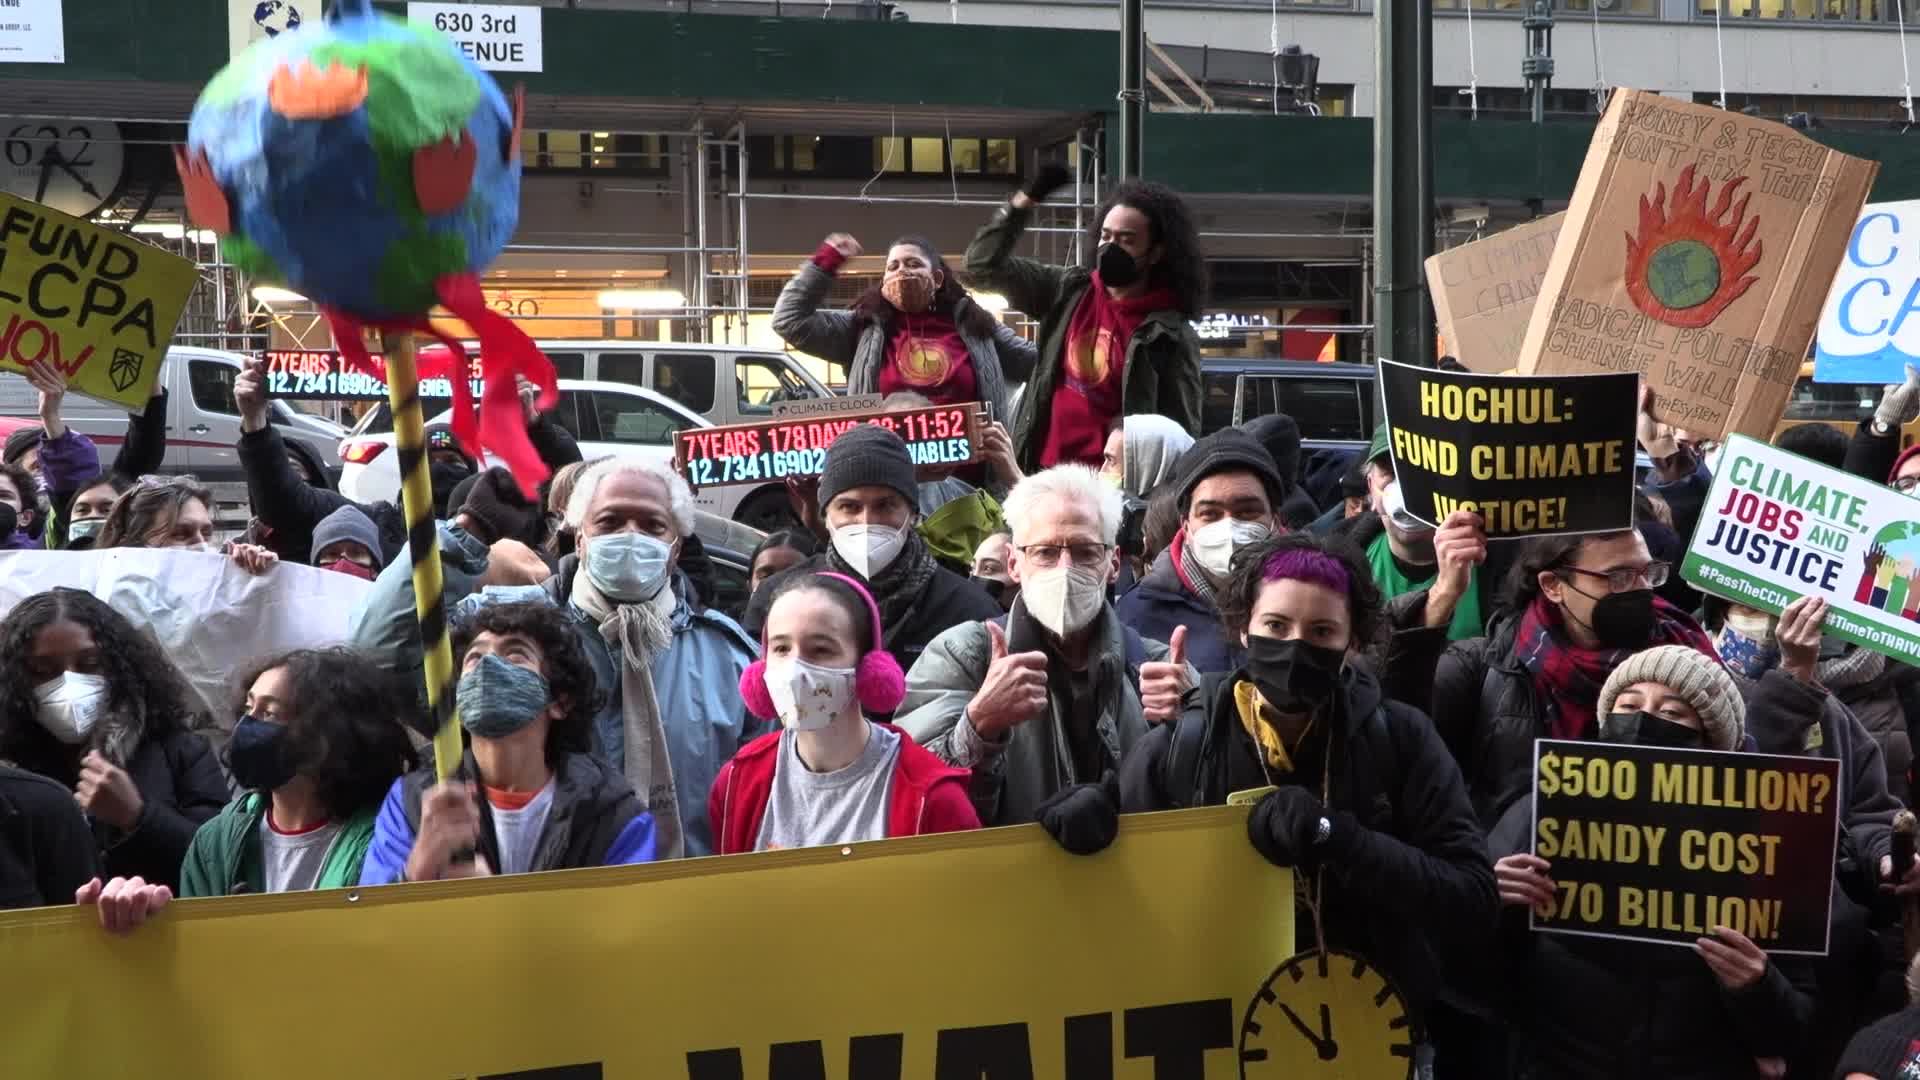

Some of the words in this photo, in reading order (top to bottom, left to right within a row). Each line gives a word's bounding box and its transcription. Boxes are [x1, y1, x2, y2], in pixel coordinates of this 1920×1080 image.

[434, 12, 474, 32] 630
[481, 14, 517, 33] 3rd
[455, 41, 524, 62] ENUE
[5, 125, 94, 166] 622
[1714, 121, 1738, 150] &
[1747, 128, 1828, 172] TECH
[0, 206, 139, 281] FUND
[789, 402, 835, 414] CLIMATE
[839, 399, 877, 411] CLOCK
[1420, 380, 1575, 424] HOCHUL:
[1392, 426, 1458, 476] FUND
[1471, 440, 1624, 480] CLIMATE
[1718, 488, 1804, 540] JOBS
[1807, 525, 1849, 553] AND
[1729, 456, 1870, 534] CLIMATE,
[1706, 519, 1844, 592] JUSTICE
[1539, 750, 1638, 799] $500
[1652, 762, 1831, 814] MILLION?
[1537, 817, 1667, 867] SANDY
[1679, 829, 1782, 876] COST
[1618, 886, 1783, 940] BILLION!
